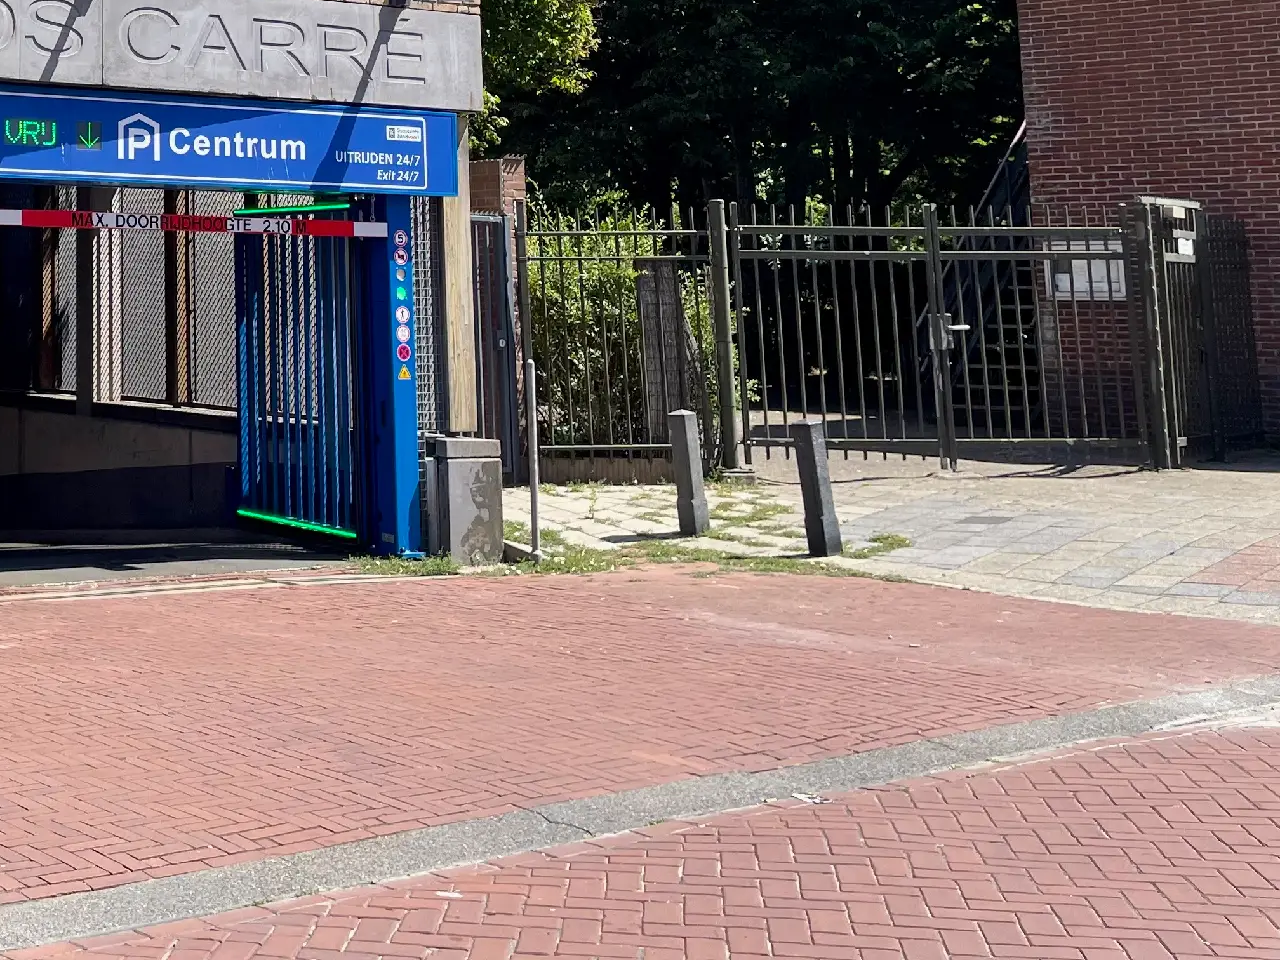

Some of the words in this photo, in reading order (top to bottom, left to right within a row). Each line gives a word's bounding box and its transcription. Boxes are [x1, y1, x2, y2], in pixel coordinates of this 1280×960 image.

[120, 6, 427, 85] CARRÉ
[4, 119, 57, 146] VRIJ
[168, 126, 306, 160] Centrum
[335, 150, 393, 165] UITRIJDEN
[396, 153, 420, 166] 24/7
[376, 169, 396, 181] Exit
[396, 170, 419, 182] 24/7
[71, 212, 109, 228] MAX.
[115, 214, 251, 233] DOORRIJDHOOGTE
[262, 219, 291, 234] 2.10
[296, 221, 307, 234] M
[397, 233, 404, 244] 5
